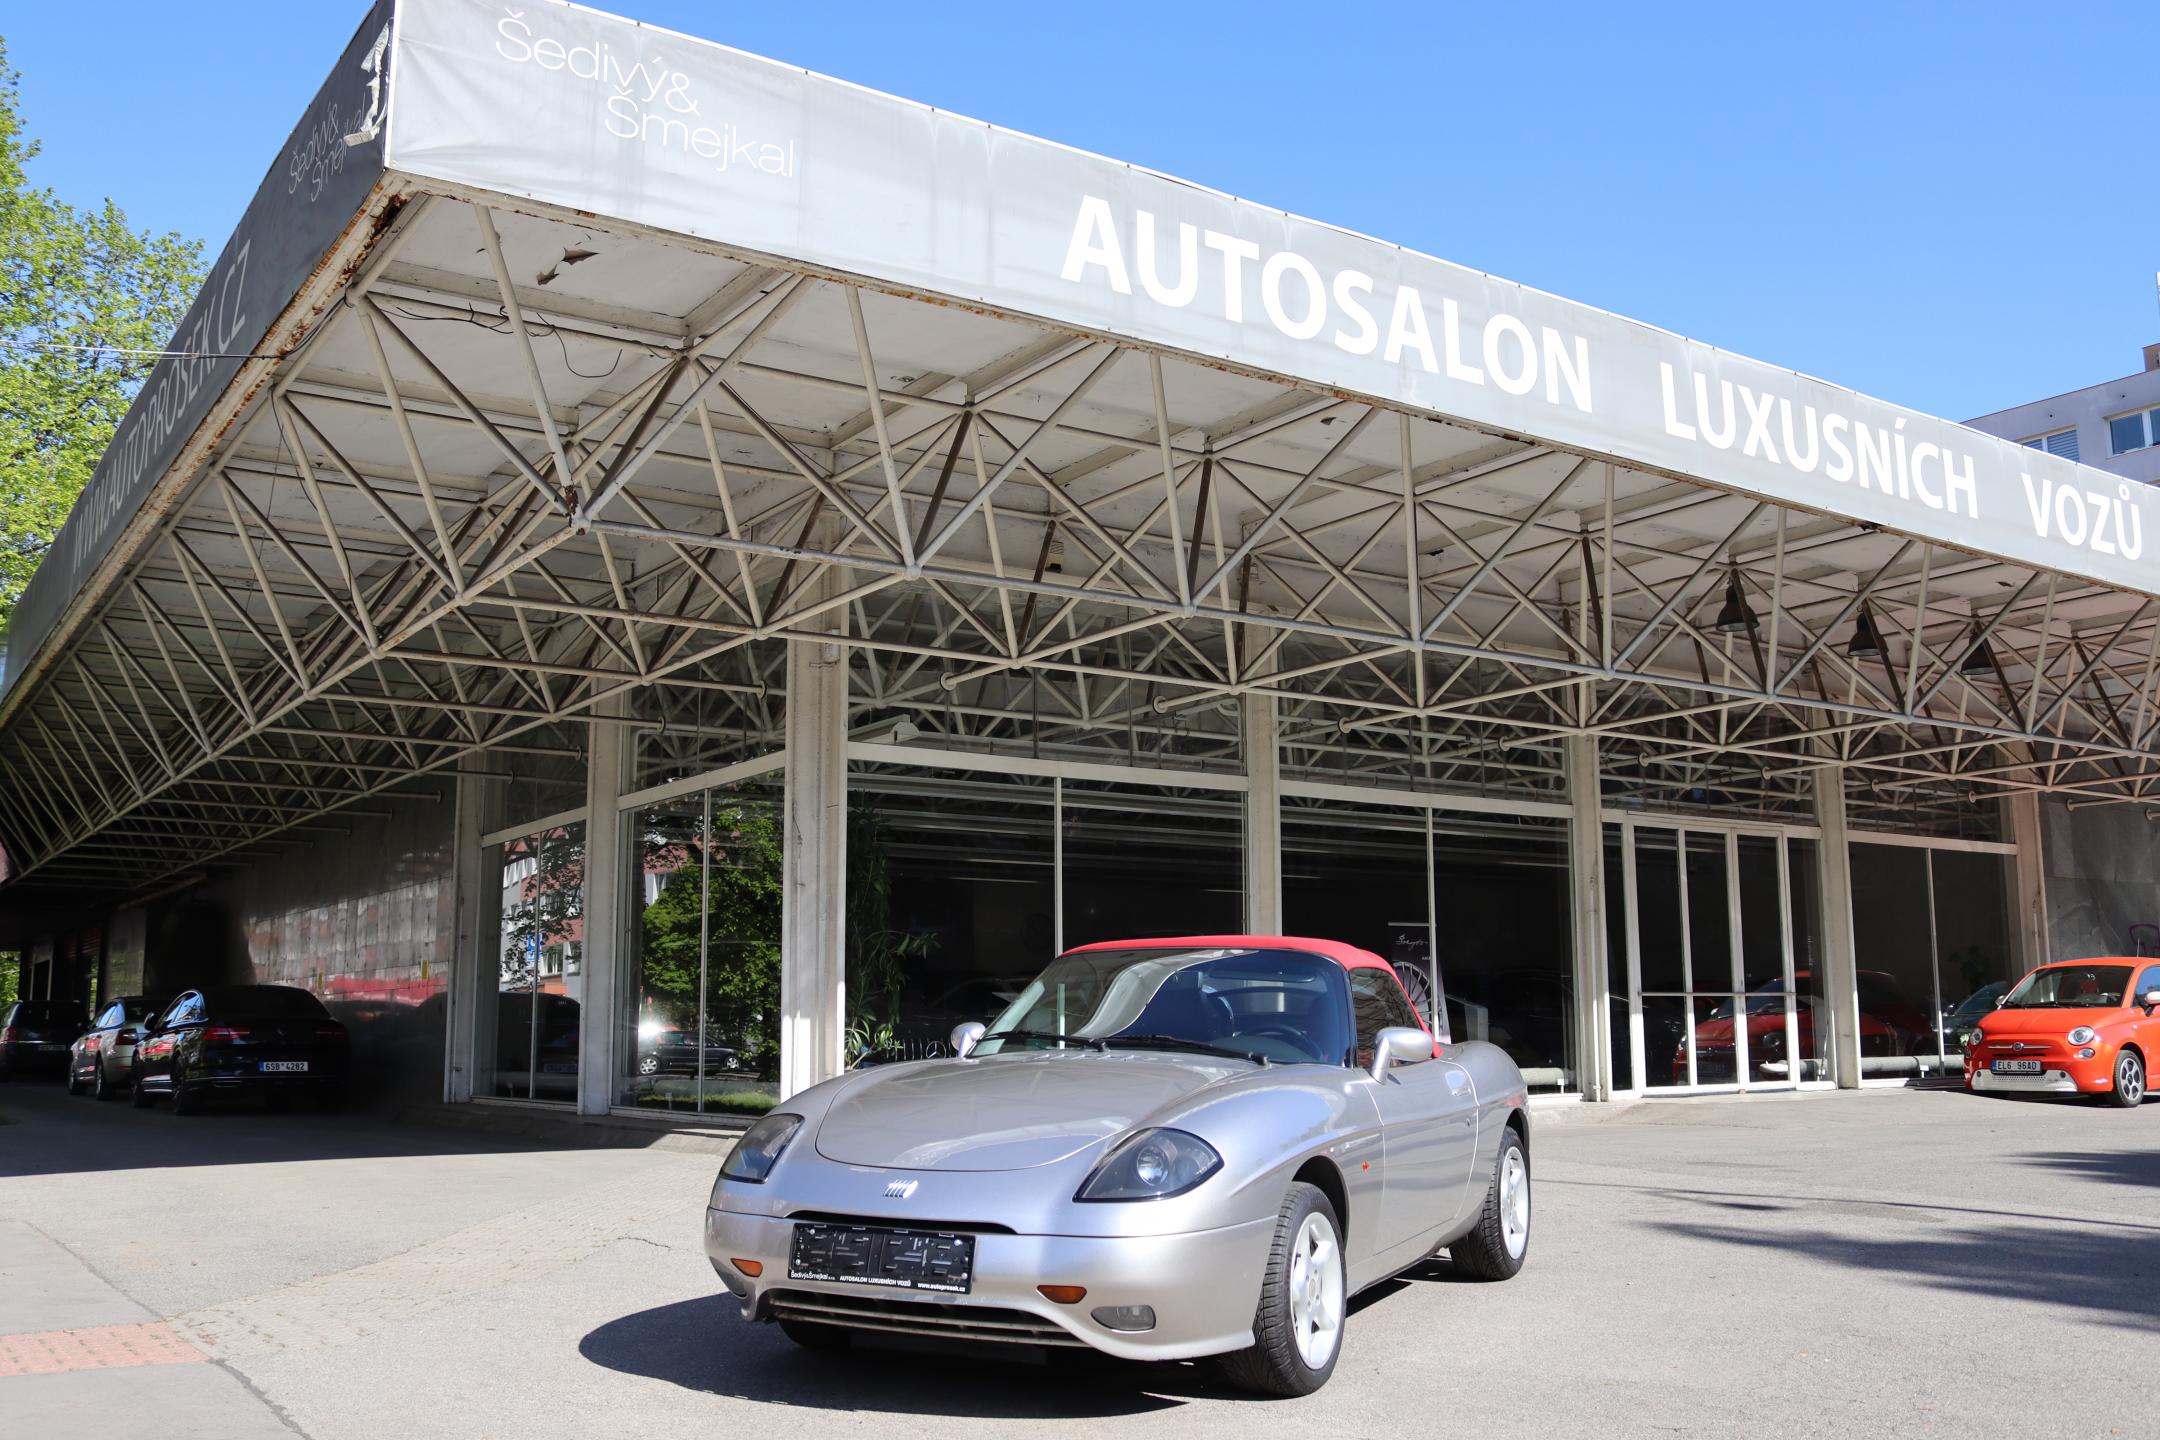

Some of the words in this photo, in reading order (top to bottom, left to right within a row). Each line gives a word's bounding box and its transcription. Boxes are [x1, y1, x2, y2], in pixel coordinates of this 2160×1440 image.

[604, 84, 795, 177] Šmejkal
[1060, 194, 1594, 414] AUTOSALON
[1659, 361, 1980, 520] LUXUSNÍCH
[2020, 471, 2143, 561] VOZŮ
[265, 1062, 281, 1071] 6SB
[286, 1062, 305, 1071] 4282
[1997, 1061, 2012, 1070] EL6
[839, 1275, 868, 1283] AUTOSALON
